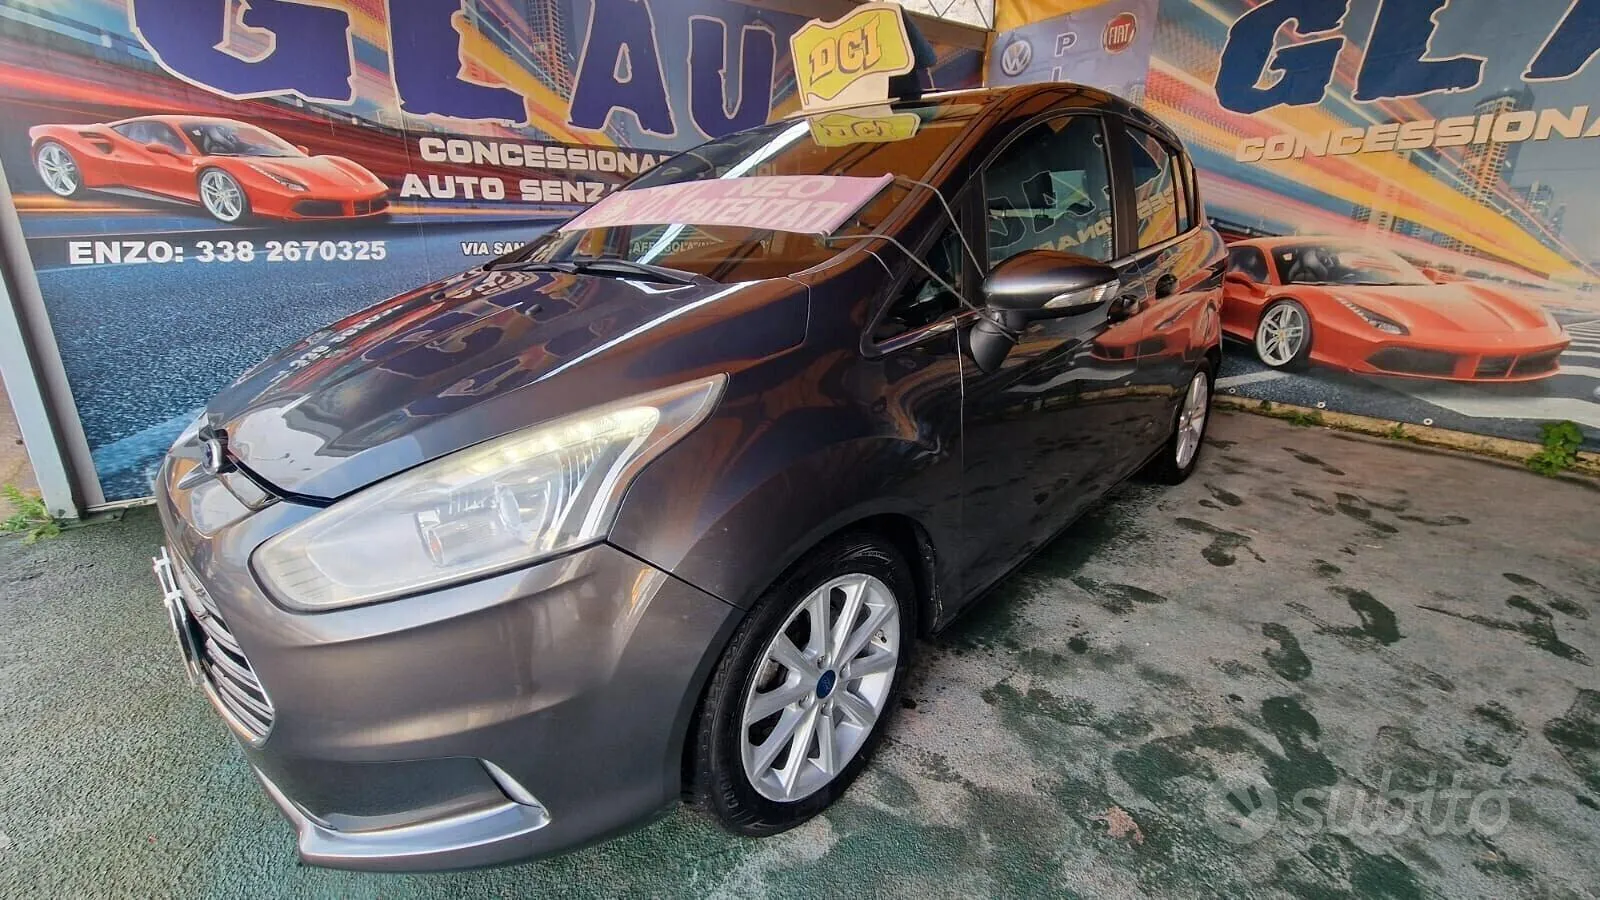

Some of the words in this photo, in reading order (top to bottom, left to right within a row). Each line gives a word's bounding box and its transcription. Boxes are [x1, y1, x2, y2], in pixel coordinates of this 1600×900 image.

[419, 137, 672, 174] CONCESSIONA
[400, 173, 505, 200] AUTO
[519, 178, 620, 204] SENZ
[722, 177, 833, 199] NEO
[68, 240, 184, 265] ENZO:
[195, 240, 255, 262] 338
[265, 240, 387, 262] 2670325
[460, 241, 490, 256] VIA
